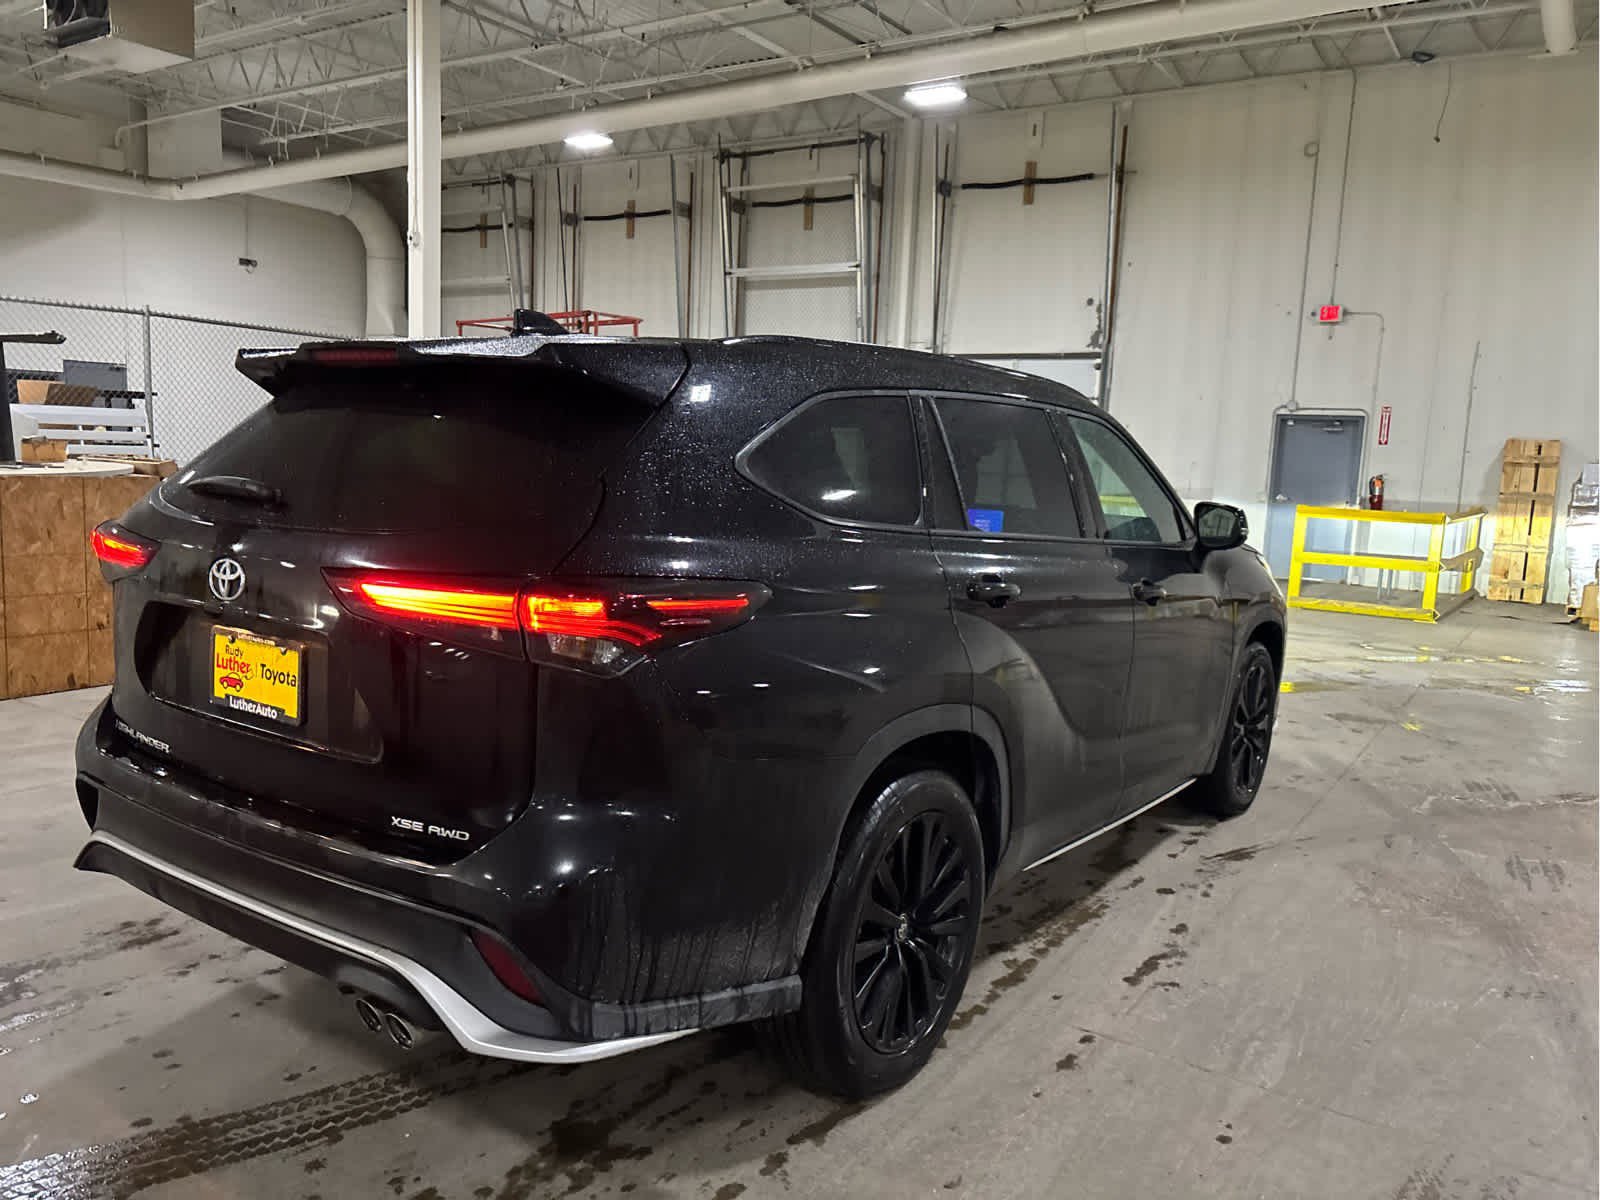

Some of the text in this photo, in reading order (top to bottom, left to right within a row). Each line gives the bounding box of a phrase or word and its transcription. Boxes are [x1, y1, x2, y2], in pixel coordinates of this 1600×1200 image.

[216, 653, 251, 674] Luther
[226, 645, 244, 660] Rudy
[260, 663, 297, 688] Toyota
[229, 695, 278, 719] LutherAuto
[391, 816, 470, 841] XSE AWD
